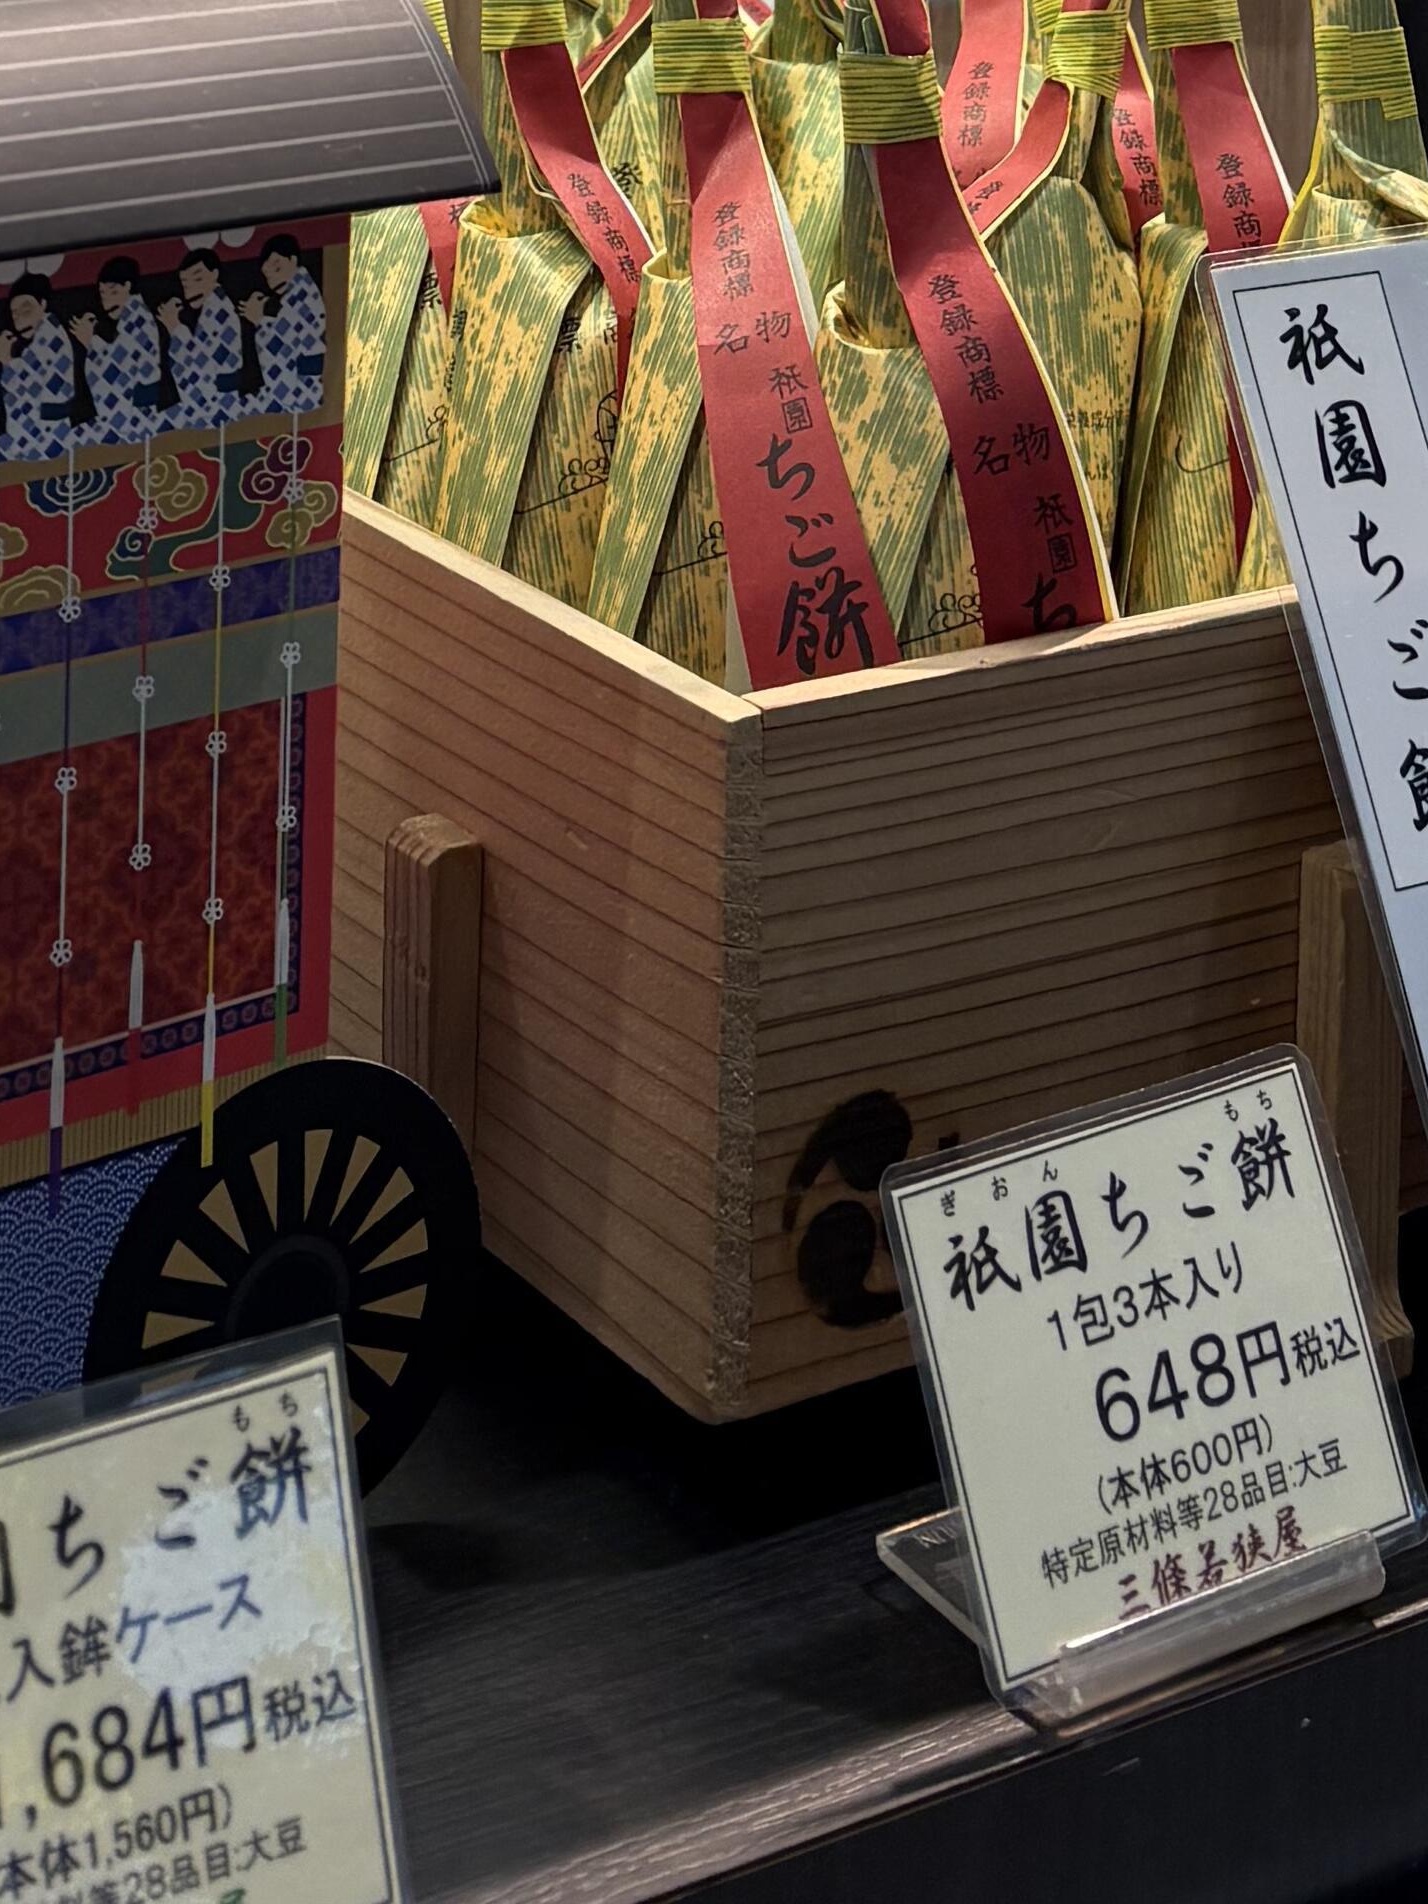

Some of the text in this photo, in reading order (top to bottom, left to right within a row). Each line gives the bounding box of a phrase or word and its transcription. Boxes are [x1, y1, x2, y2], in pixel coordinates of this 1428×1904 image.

[712, 200, 756, 304] 登録商標
[1214, 152, 1263, 252] 登録商
[714, 310, 792, 357] 名物
[927, 273, 1005, 404] 登録商標
[768, 364, 812, 435] 祇園
[973, 422, 1052, 477] 名物
[755, 432, 873, 678] ちご餅
[1033, 491, 1079, 575] 祇園
[942, 1116, 1297, 1313] 祇園ちご餅
[1046, 1239, 1245, 1353] 1包3本入り
[1039, 1436, 1349, 1589] 特定原材料等28品目:大豆
[1096, 1411, 1274, 1516] (本体600円)
